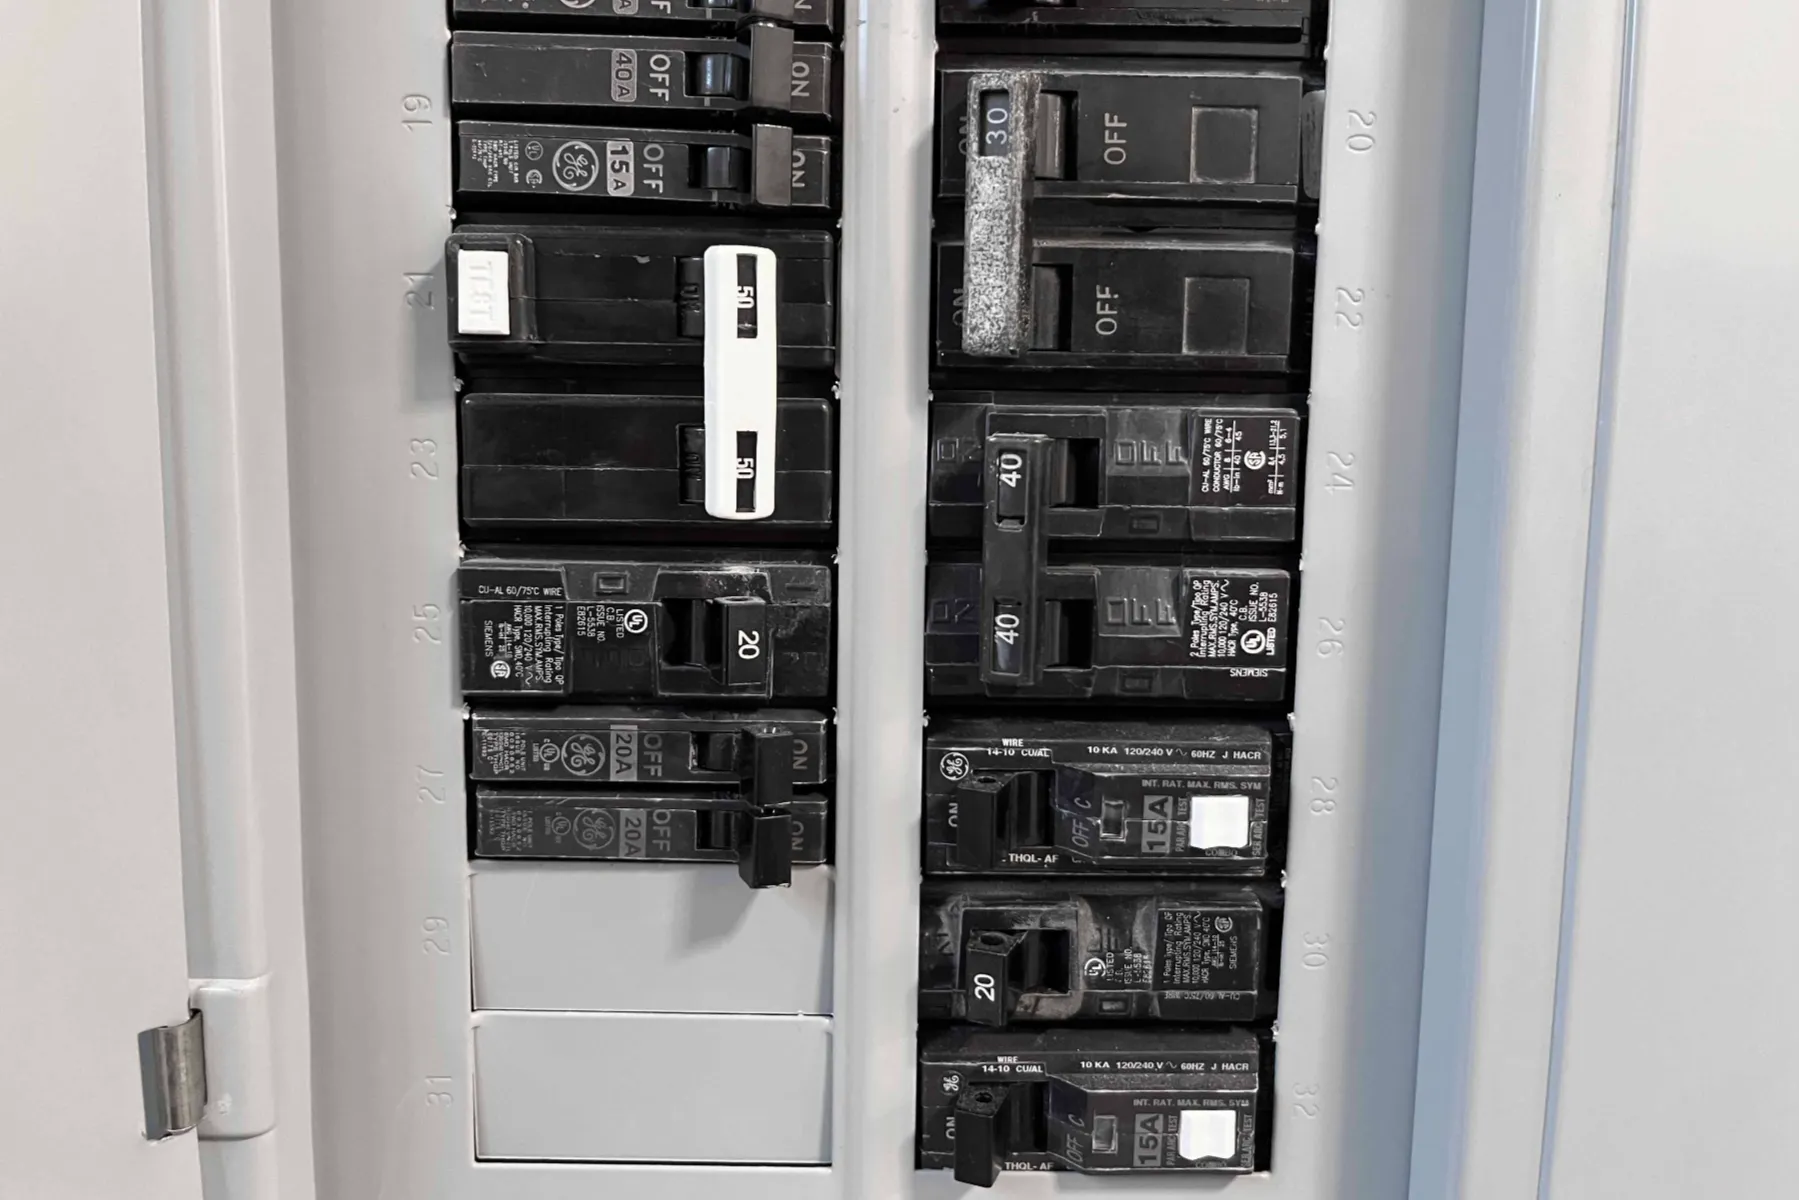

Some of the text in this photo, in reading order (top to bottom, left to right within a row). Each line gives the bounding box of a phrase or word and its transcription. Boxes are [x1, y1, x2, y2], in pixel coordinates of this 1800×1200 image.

[613, 54, 633, 99] 40A
[649, 54, 670, 101] OFF
[791, 61, 809, 97] ON
[403, 95, 433, 131] 19
[985, 108, 1008, 145] 30
[1104, 112, 1127, 165] OFF
[1346, 109, 1376, 154] 20
[609, 144, 631, 192] 15A
[643, 143, 664, 194] OFF
[791, 150, 806, 188] ON
[403, 272, 434, 309] 21
[737, 286, 756, 309] 50
[1096, 285, 1117, 336] OFF
[1335, 287, 1364, 331] 22
[410, 438, 439, 480] 23
[737, 457, 756, 480] 50
[999, 453, 1022, 488] 40
[1212, 451, 1223, 493] CONDUCTOR
[1325, 451, 1355, 494] 24
[1201, 469, 1211, 492] CU-AL
[479, 585, 504, 595] CU-AL
[543, 587, 563, 597] WIRE
[1267, 592, 1278, 622] E82615
[414, 604, 441, 644] 25
[576, 605, 586, 636] E82615
[596, 605, 605, 627] ISSUE
[616, 608, 625, 639] LISTED
[1199, 580, 1211, 657] Interrupting Rating
[1218, 602, 1229, 634] 120/240
[1248, 599, 1258, 622] ISSUE
[484, 620, 494, 657] SIEMENS
[523, 630, 533, 661] 120/240
[543, 605, 554, 684] Interrupting Rating
[737, 629, 760, 660] 20
[995, 613, 1020, 645] 40
[1265, 627, 1276, 656] LISTED
[1318, 616, 1345, 658] 26
[1229, 668, 1268, 678] SIEMENS
[615, 732, 633, 774] 20A
[644, 735, 662, 777] OFF
[792, 739, 808, 769] ON
[987, 748, 1050, 758] 14-10 CU/AL
[1002, 738, 1024, 747] WIRE
[1087, 745, 1262, 761] 10 KA 120/240 V 60HZ J HACR
[418, 764, 443, 802] 27
[1240, 781, 1262, 791] SYM
[1310, 776, 1338, 815] 28
[1146, 796, 1170, 851] 15A
[1177, 796, 1188, 816] TEST
[1254, 797, 1265, 817] TEST
[624, 817, 641, 857] 20A
[652, 809, 670, 852] OFF
[791, 822, 803, 850] ON
[1072, 818, 1090, 849] OFF
[422, 916, 450, 954] 29
[1302, 931, 1330, 970] 30
[1228, 936, 1238, 970] SIEMENS
[974, 973, 995, 1001] 20
[982, 1065, 1043, 1073] 14-10 CU/AL
[1080, 1061, 1093, 1069] 10
[1094, 1061, 1110, 1070] KA
[1116, 1061, 1154, 1070] 120/240
[1155, 1062, 1164, 1070] V
[1181, 1063, 1205, 1072] 60HZ
[1221, 1063, 1250, 1072] HACR
[425, 1075, 453, 1107] 31
[1293, 1083, 1319, 1120] 32
[1137, 1114, 1161, 1166] 15A
[1168, 1114, 1178, 1132] TEST
[1243, 1113, 1253, 1132] TEST
[1066, 1134, 1084, 1163] OFF
